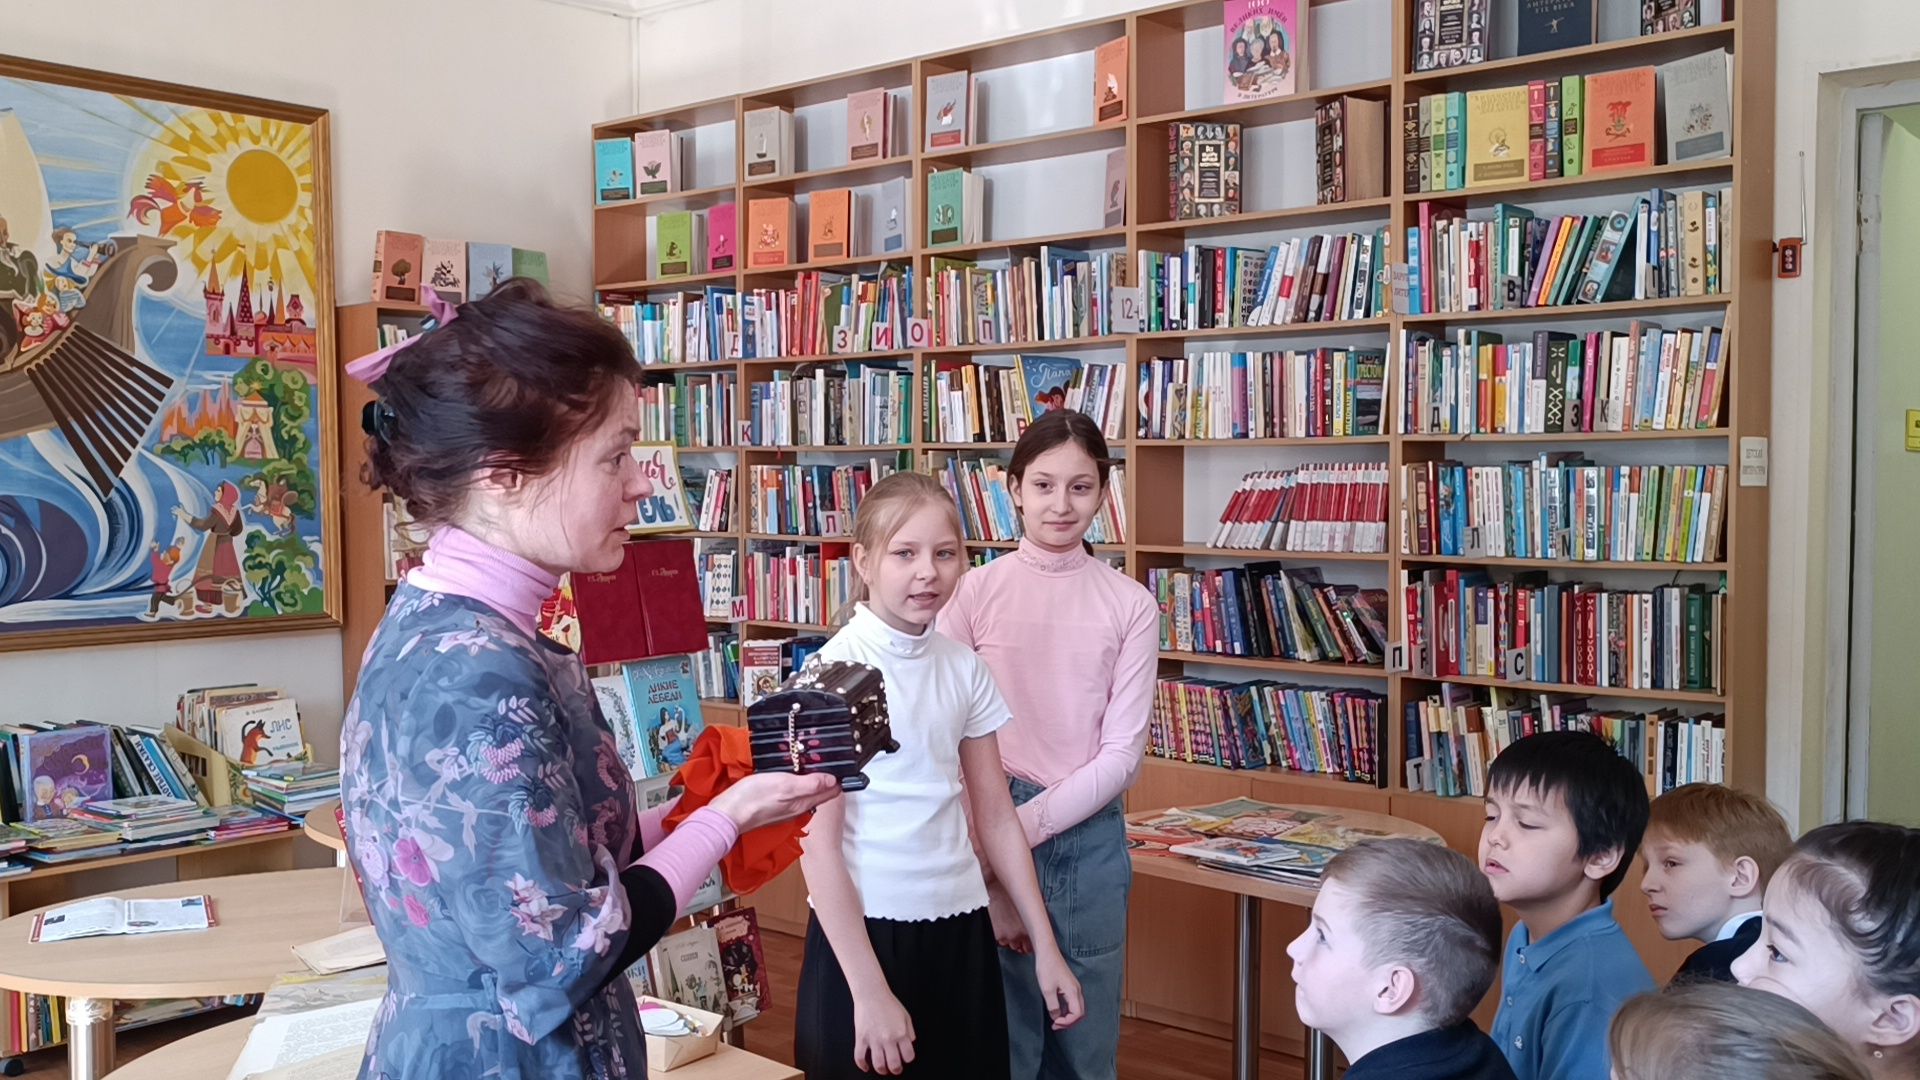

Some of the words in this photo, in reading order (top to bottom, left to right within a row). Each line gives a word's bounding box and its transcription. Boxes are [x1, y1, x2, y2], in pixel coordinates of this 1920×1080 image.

[1507, 279, 1516, 302] В
[837, 329, 848, 349] З
[876, 326, 888, 347] И
[911, 322, 924, 343] О
[982, 319, 993, 340] П
[1431, 406, 1441, 432] Д
[1571, 404, 1580, 427] З
[1600, 400, 1609, 423] К
[742, 424, 752, 442] К
[825, 515, 836, 533] Л
[1470, 527, 1480, 549] Л
[731, 599, 744, 618] М
[1392, 646, 1403, 668] П
[1514, 652, 1525, 675] С
[648, 679, 680, 694] ДИКИЕ
[647, 690, 683, 705] ЛЕБЕДИ
[269, 718, 293, 733] ЛИС
[134, 740, 157, 773] СКАЗКИ
[1413, 762, 1422, 785] Т
